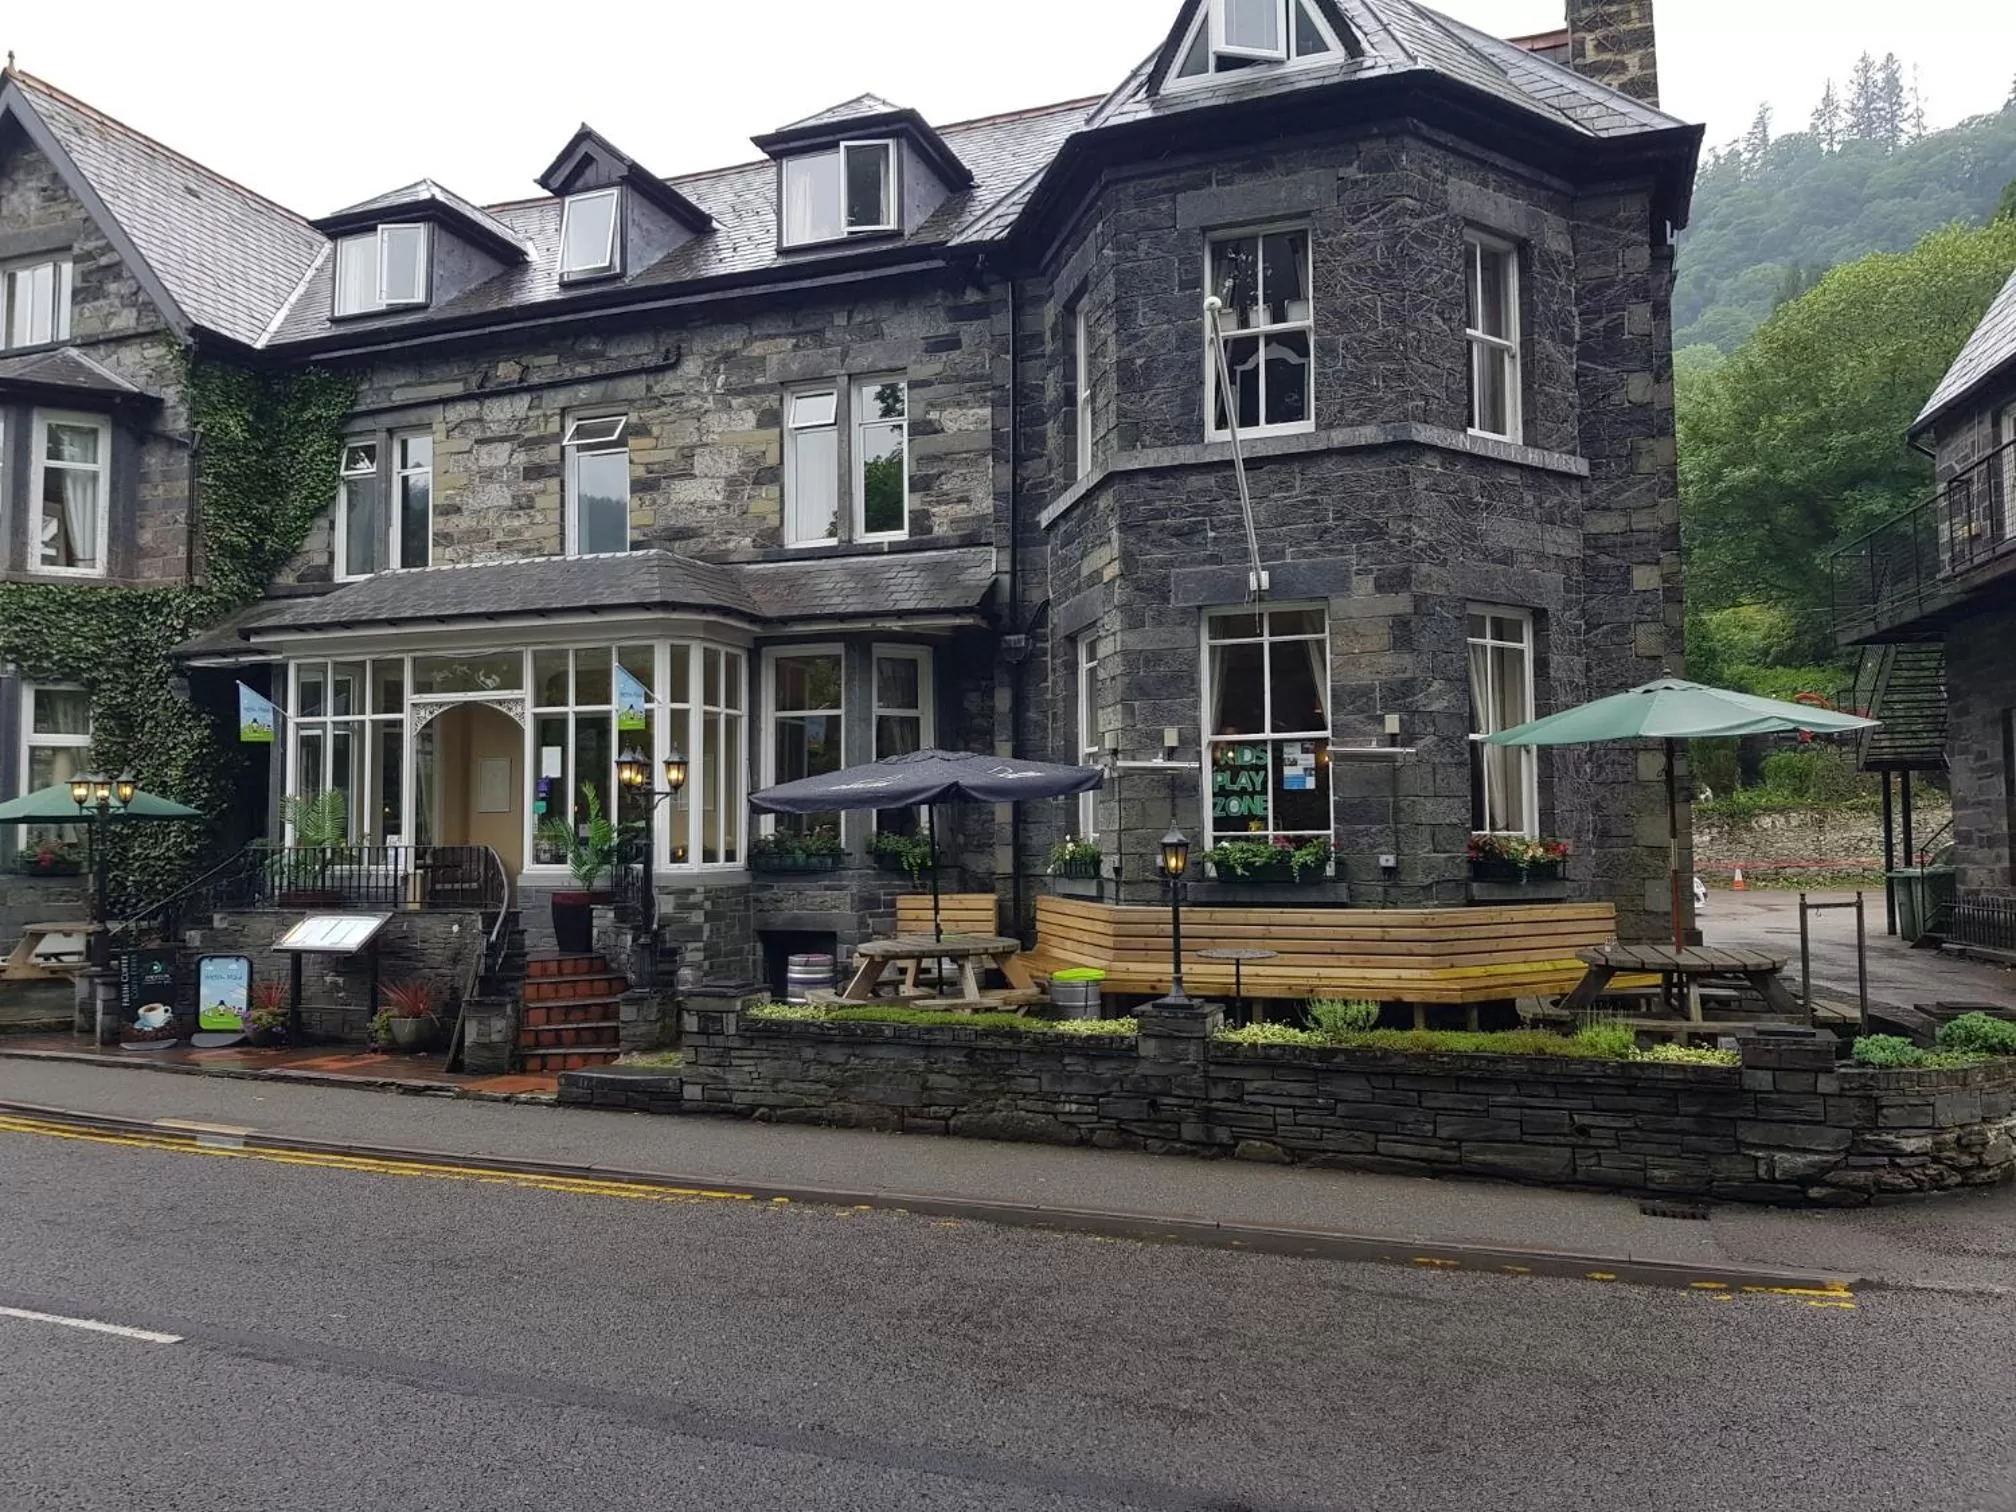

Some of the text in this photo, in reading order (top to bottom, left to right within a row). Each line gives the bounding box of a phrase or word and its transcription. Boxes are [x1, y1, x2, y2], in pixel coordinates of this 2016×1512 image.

[1218, 745, 1268, 766] KIDS
[1213, 771, 1266, 792] PLAY
[1213, 795, 1269, 817] ZONE
